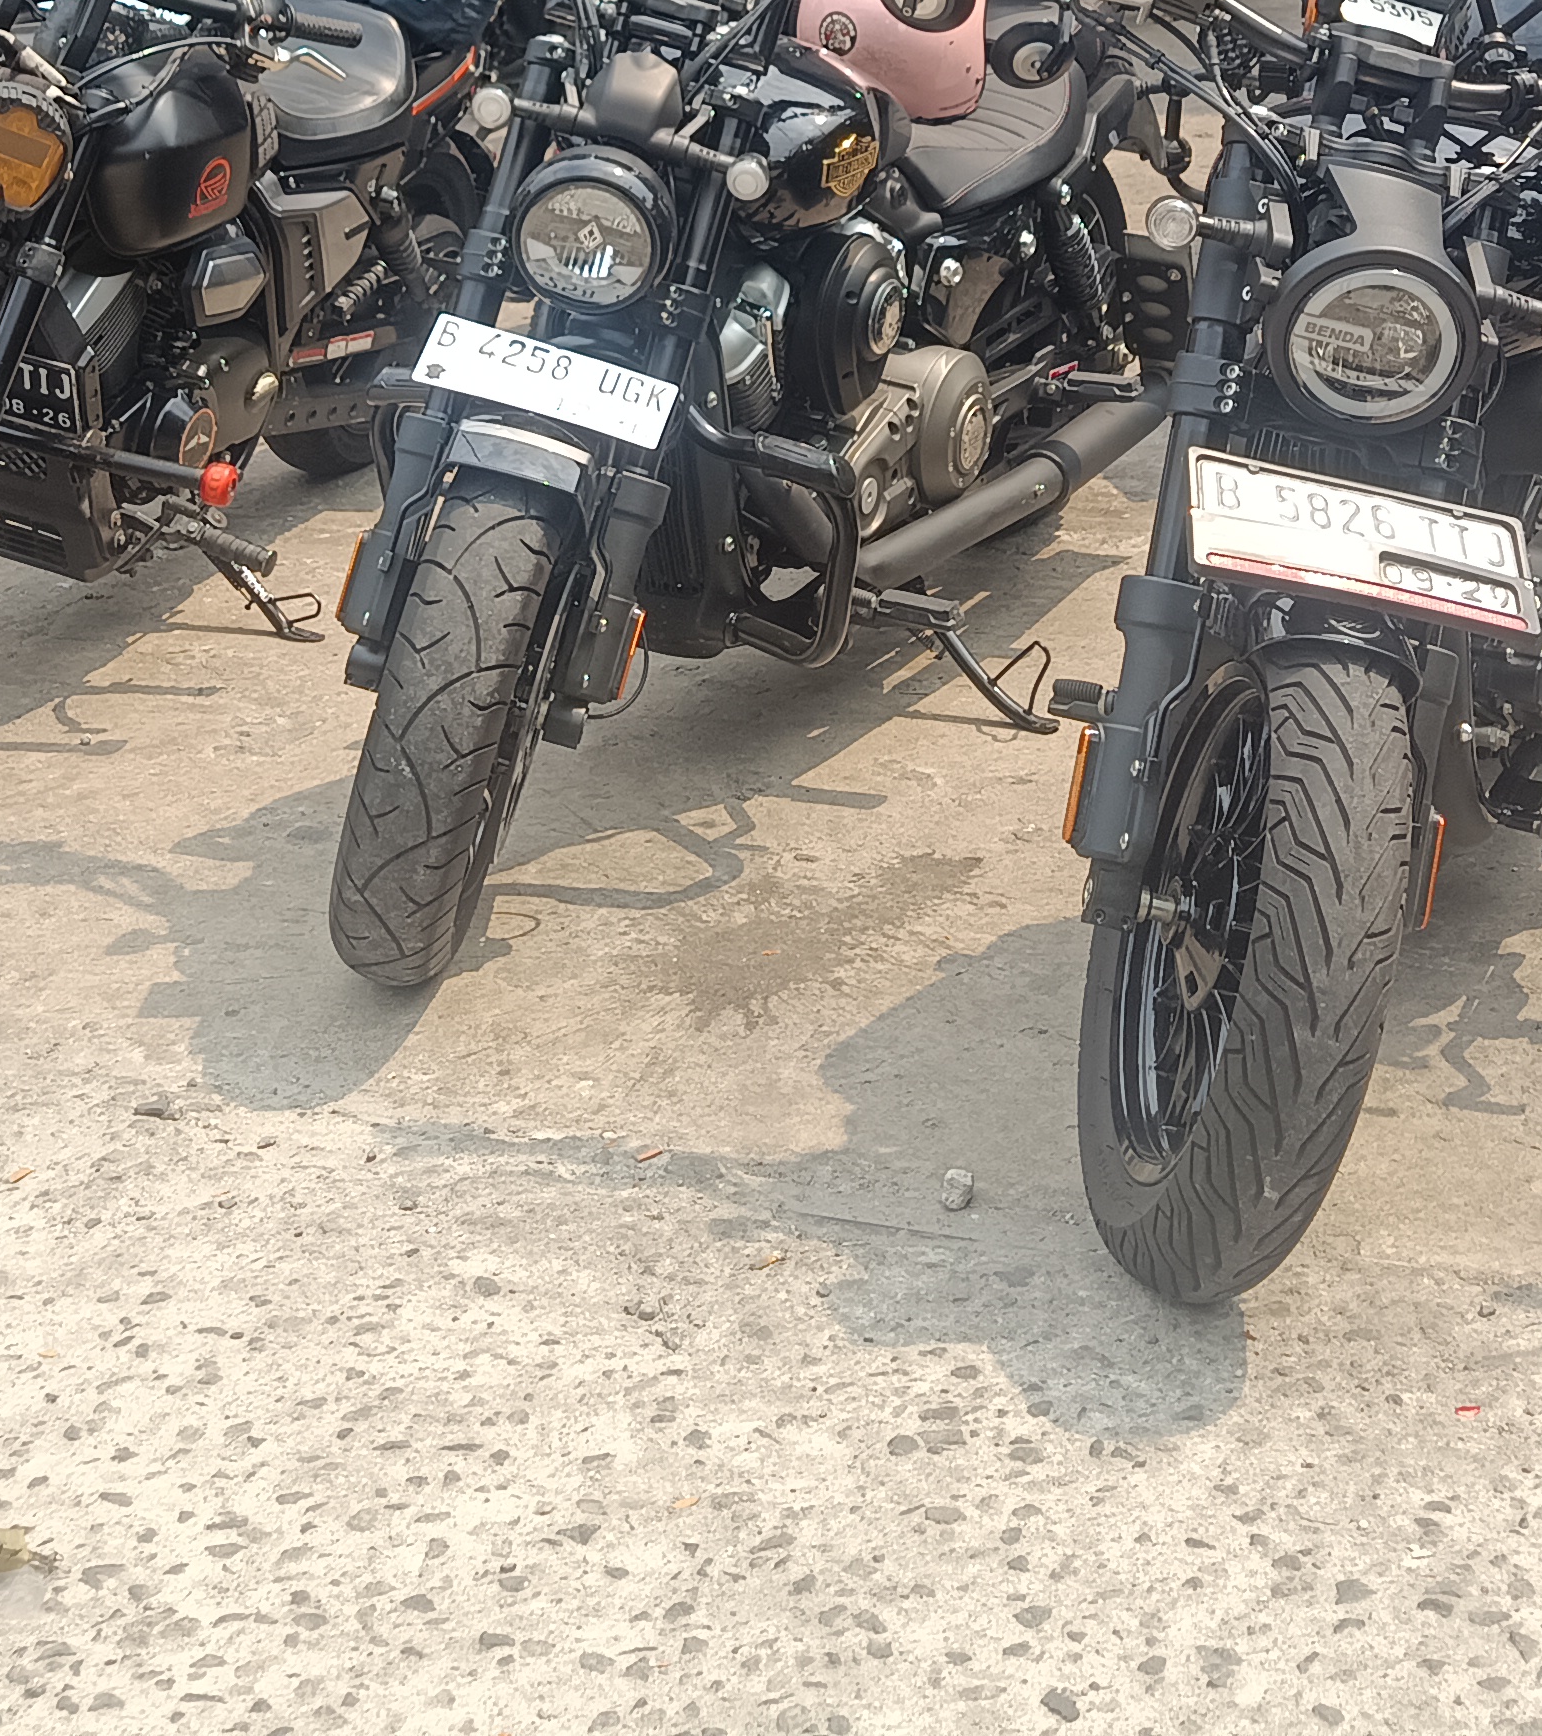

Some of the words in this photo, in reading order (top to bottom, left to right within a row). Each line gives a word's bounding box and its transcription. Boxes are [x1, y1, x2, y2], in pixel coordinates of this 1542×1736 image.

[1303, 321, 1366, 348] BENDA
[18, 362, 72, 400] TIJ
[436, 320, 460, 348] B
[478, 332, 573, 381] 4258
[597, 368, 667, 413] UGK
[1215, 471, 1241, 511] B
[1275, 484, 1397, 541] 5826
